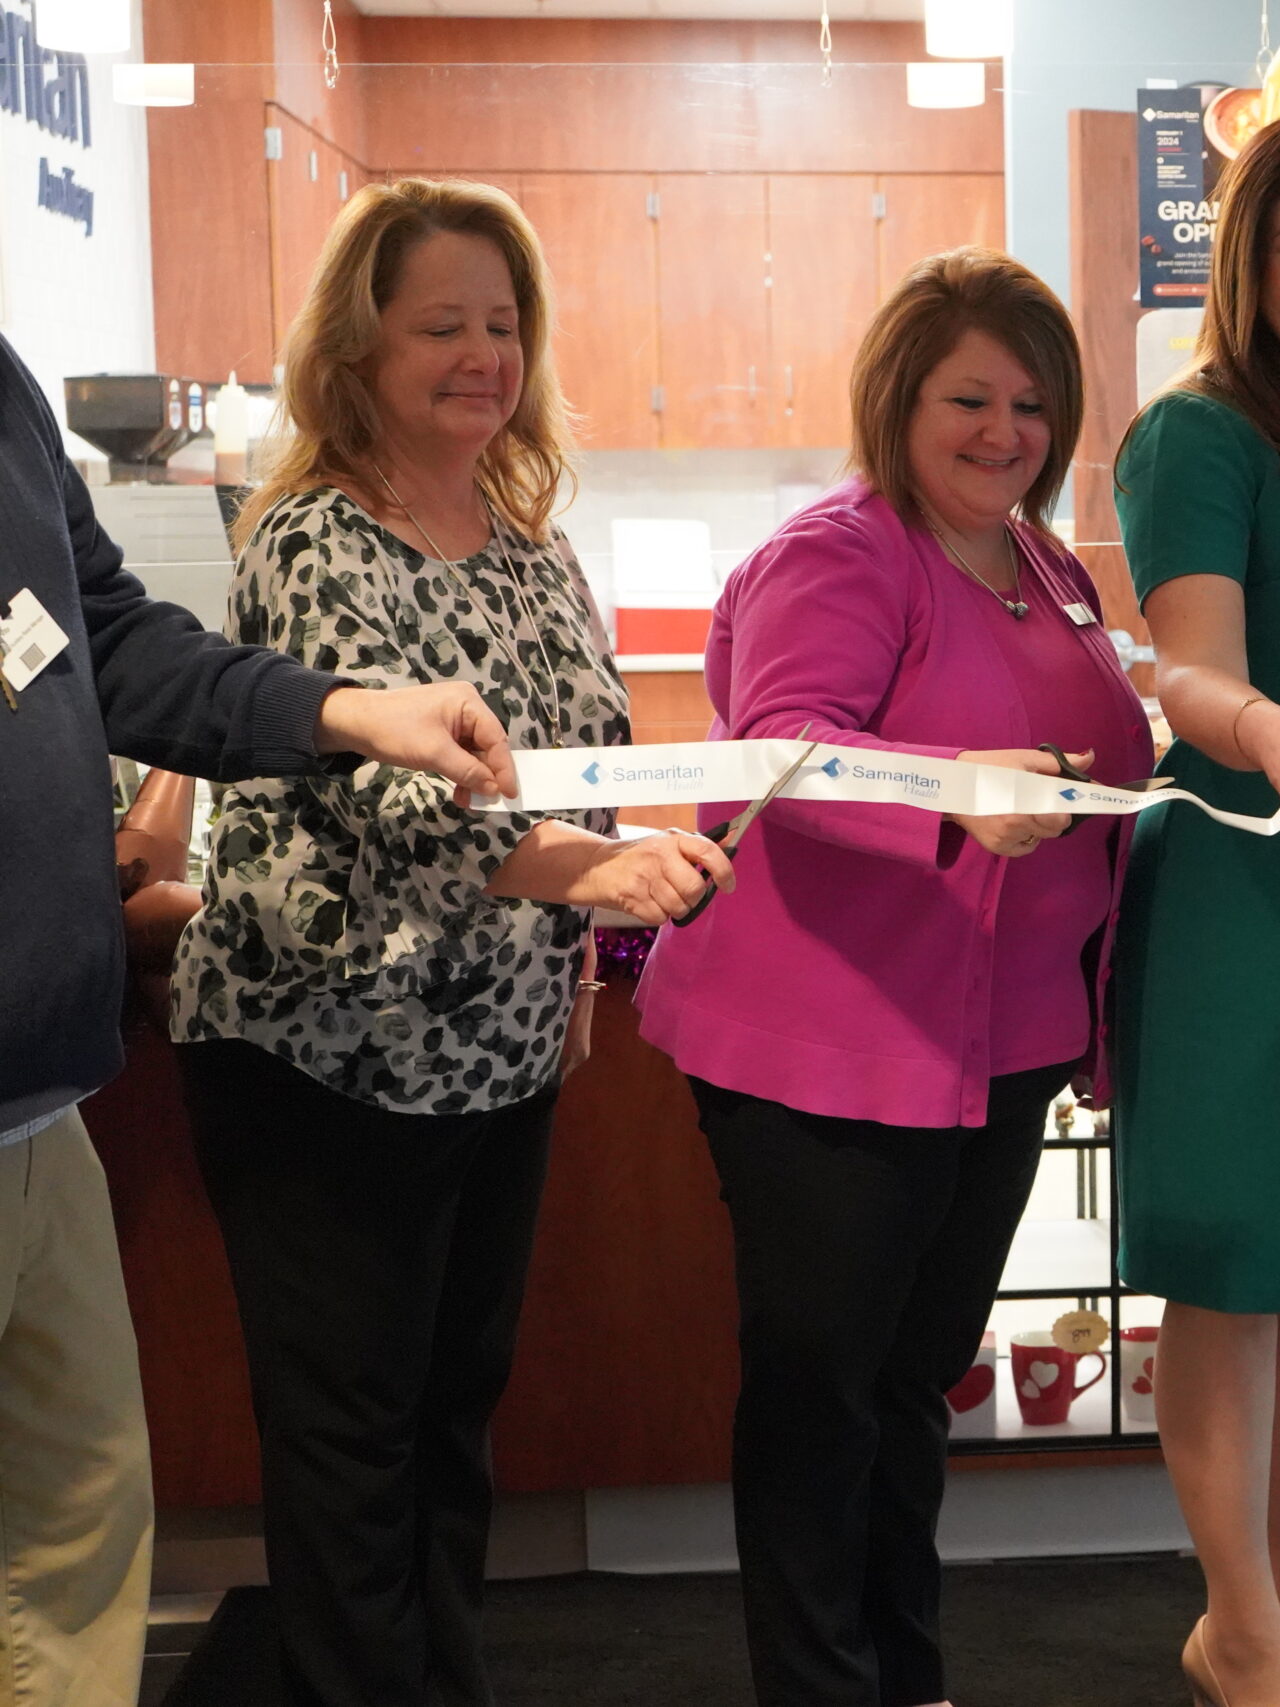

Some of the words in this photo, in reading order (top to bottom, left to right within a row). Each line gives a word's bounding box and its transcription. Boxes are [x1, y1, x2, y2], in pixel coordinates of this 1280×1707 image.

[612, 764, 704, 782] Samaritan
[852, 765, 942, 789] Samaritan
[903, 783, 940, 799] Health
